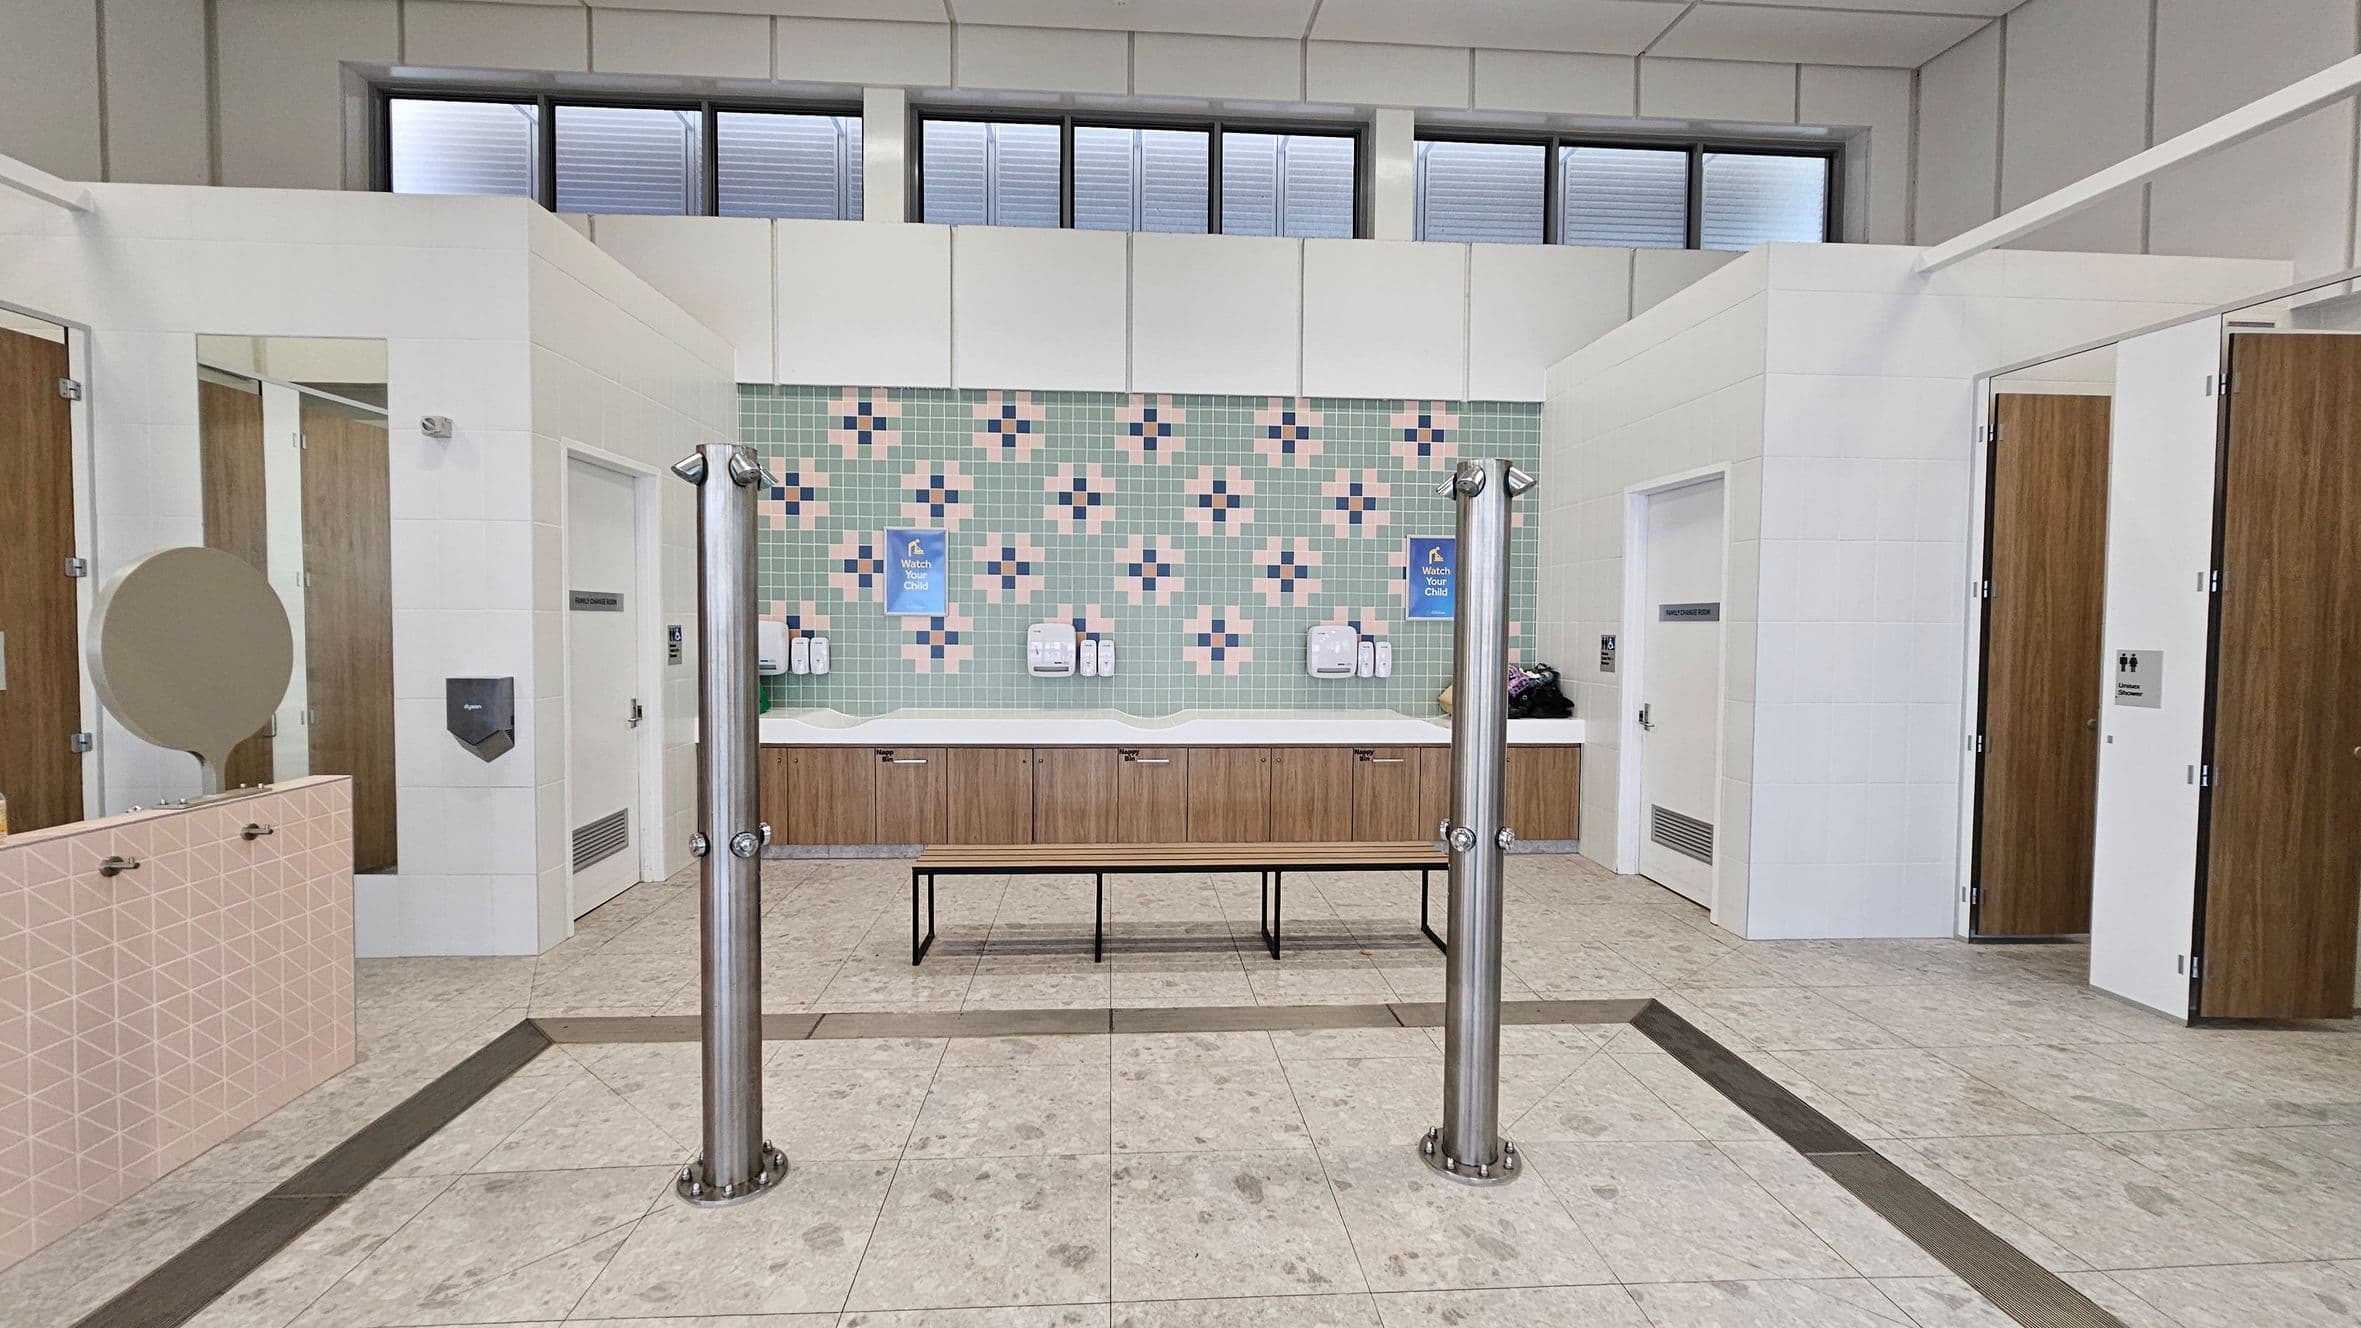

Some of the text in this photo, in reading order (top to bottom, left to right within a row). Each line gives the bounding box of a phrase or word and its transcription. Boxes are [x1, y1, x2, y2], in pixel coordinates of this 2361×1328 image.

[901, 559, 931, 568] Watch
[905, 570, 927, 579] Your
[1422, 566, 1450, 575] Watch
[903, 581, 928, 590] Child
[1426, 577, 1446, 586] Your
[1424, 587, 1448, 596] Child
[1119, 748, 1139, 756] Nappy
